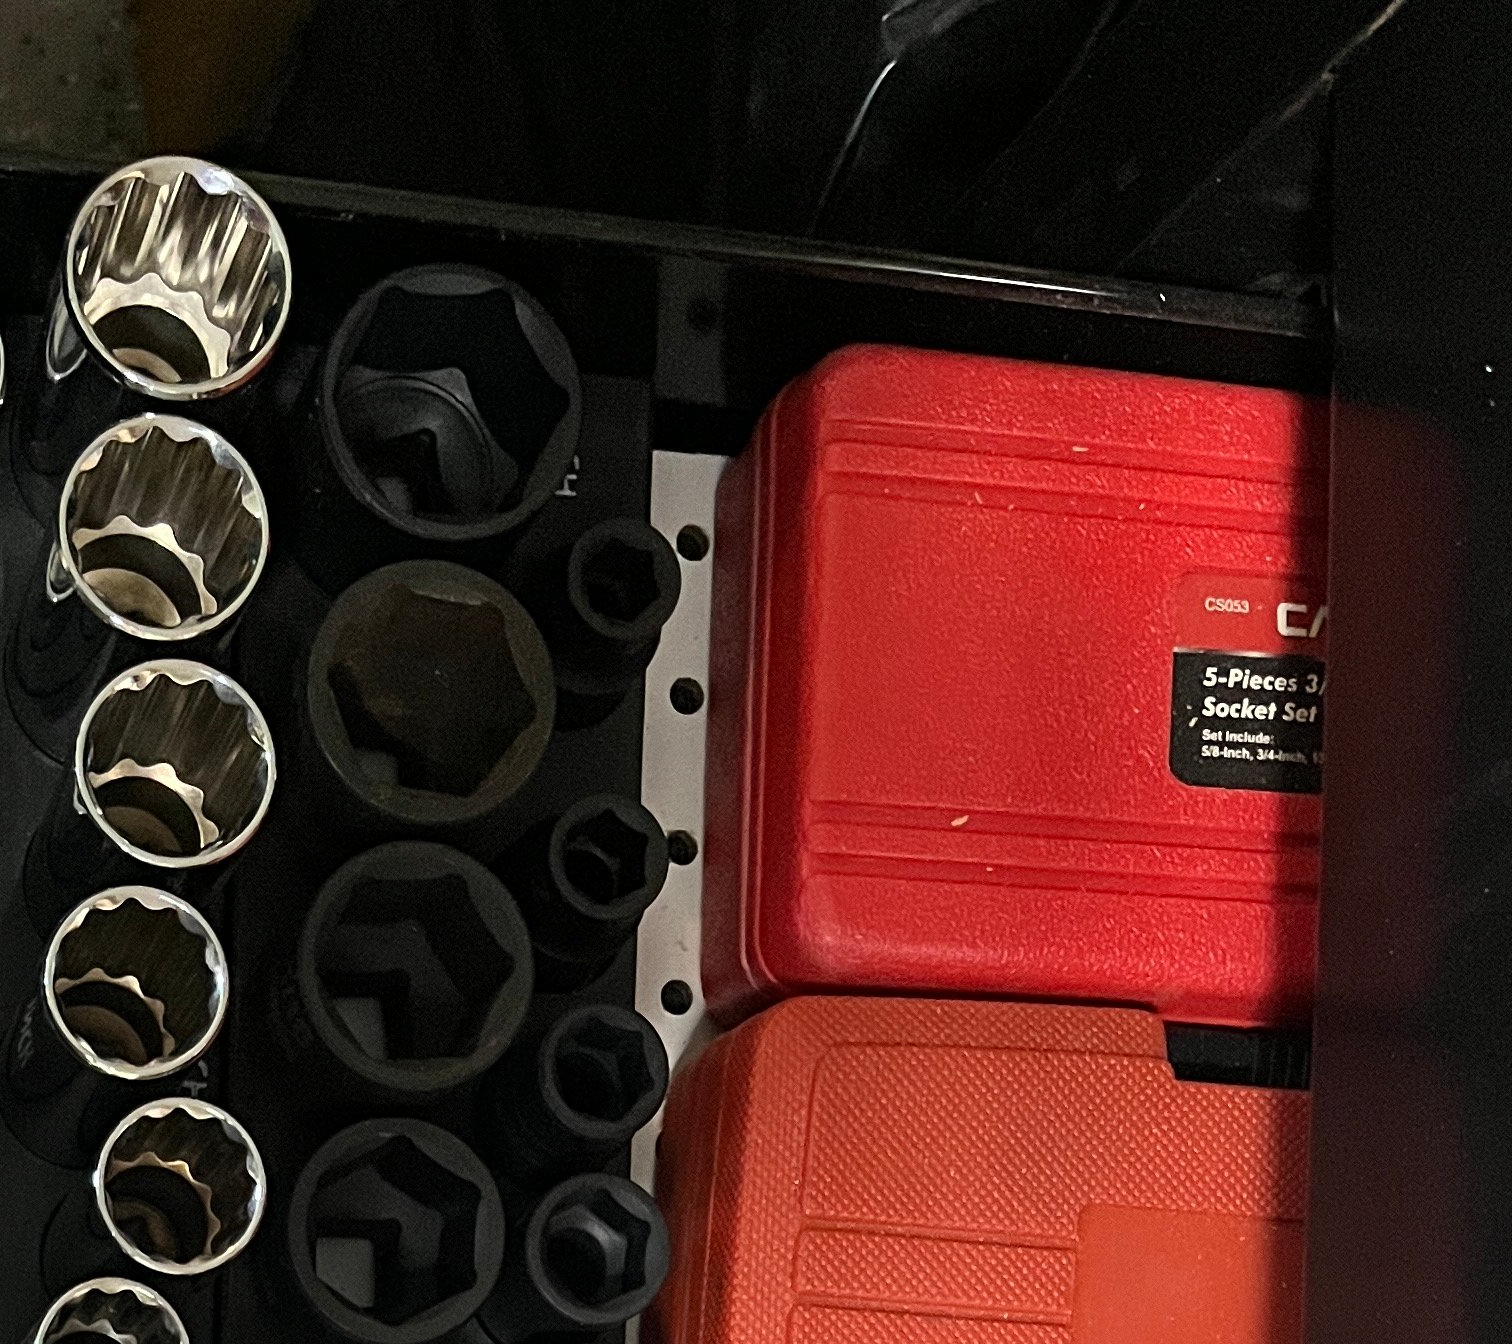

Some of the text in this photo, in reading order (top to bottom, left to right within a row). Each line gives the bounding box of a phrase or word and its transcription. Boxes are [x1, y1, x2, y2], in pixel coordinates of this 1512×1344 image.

[1204, 596, 1250, 614] CS053
[1202, 666, 1298, 692] 5-Pieces
[1201, 696, 1318, 723] Socket Set
[1201, 728, 1275, 745] Set Include:
